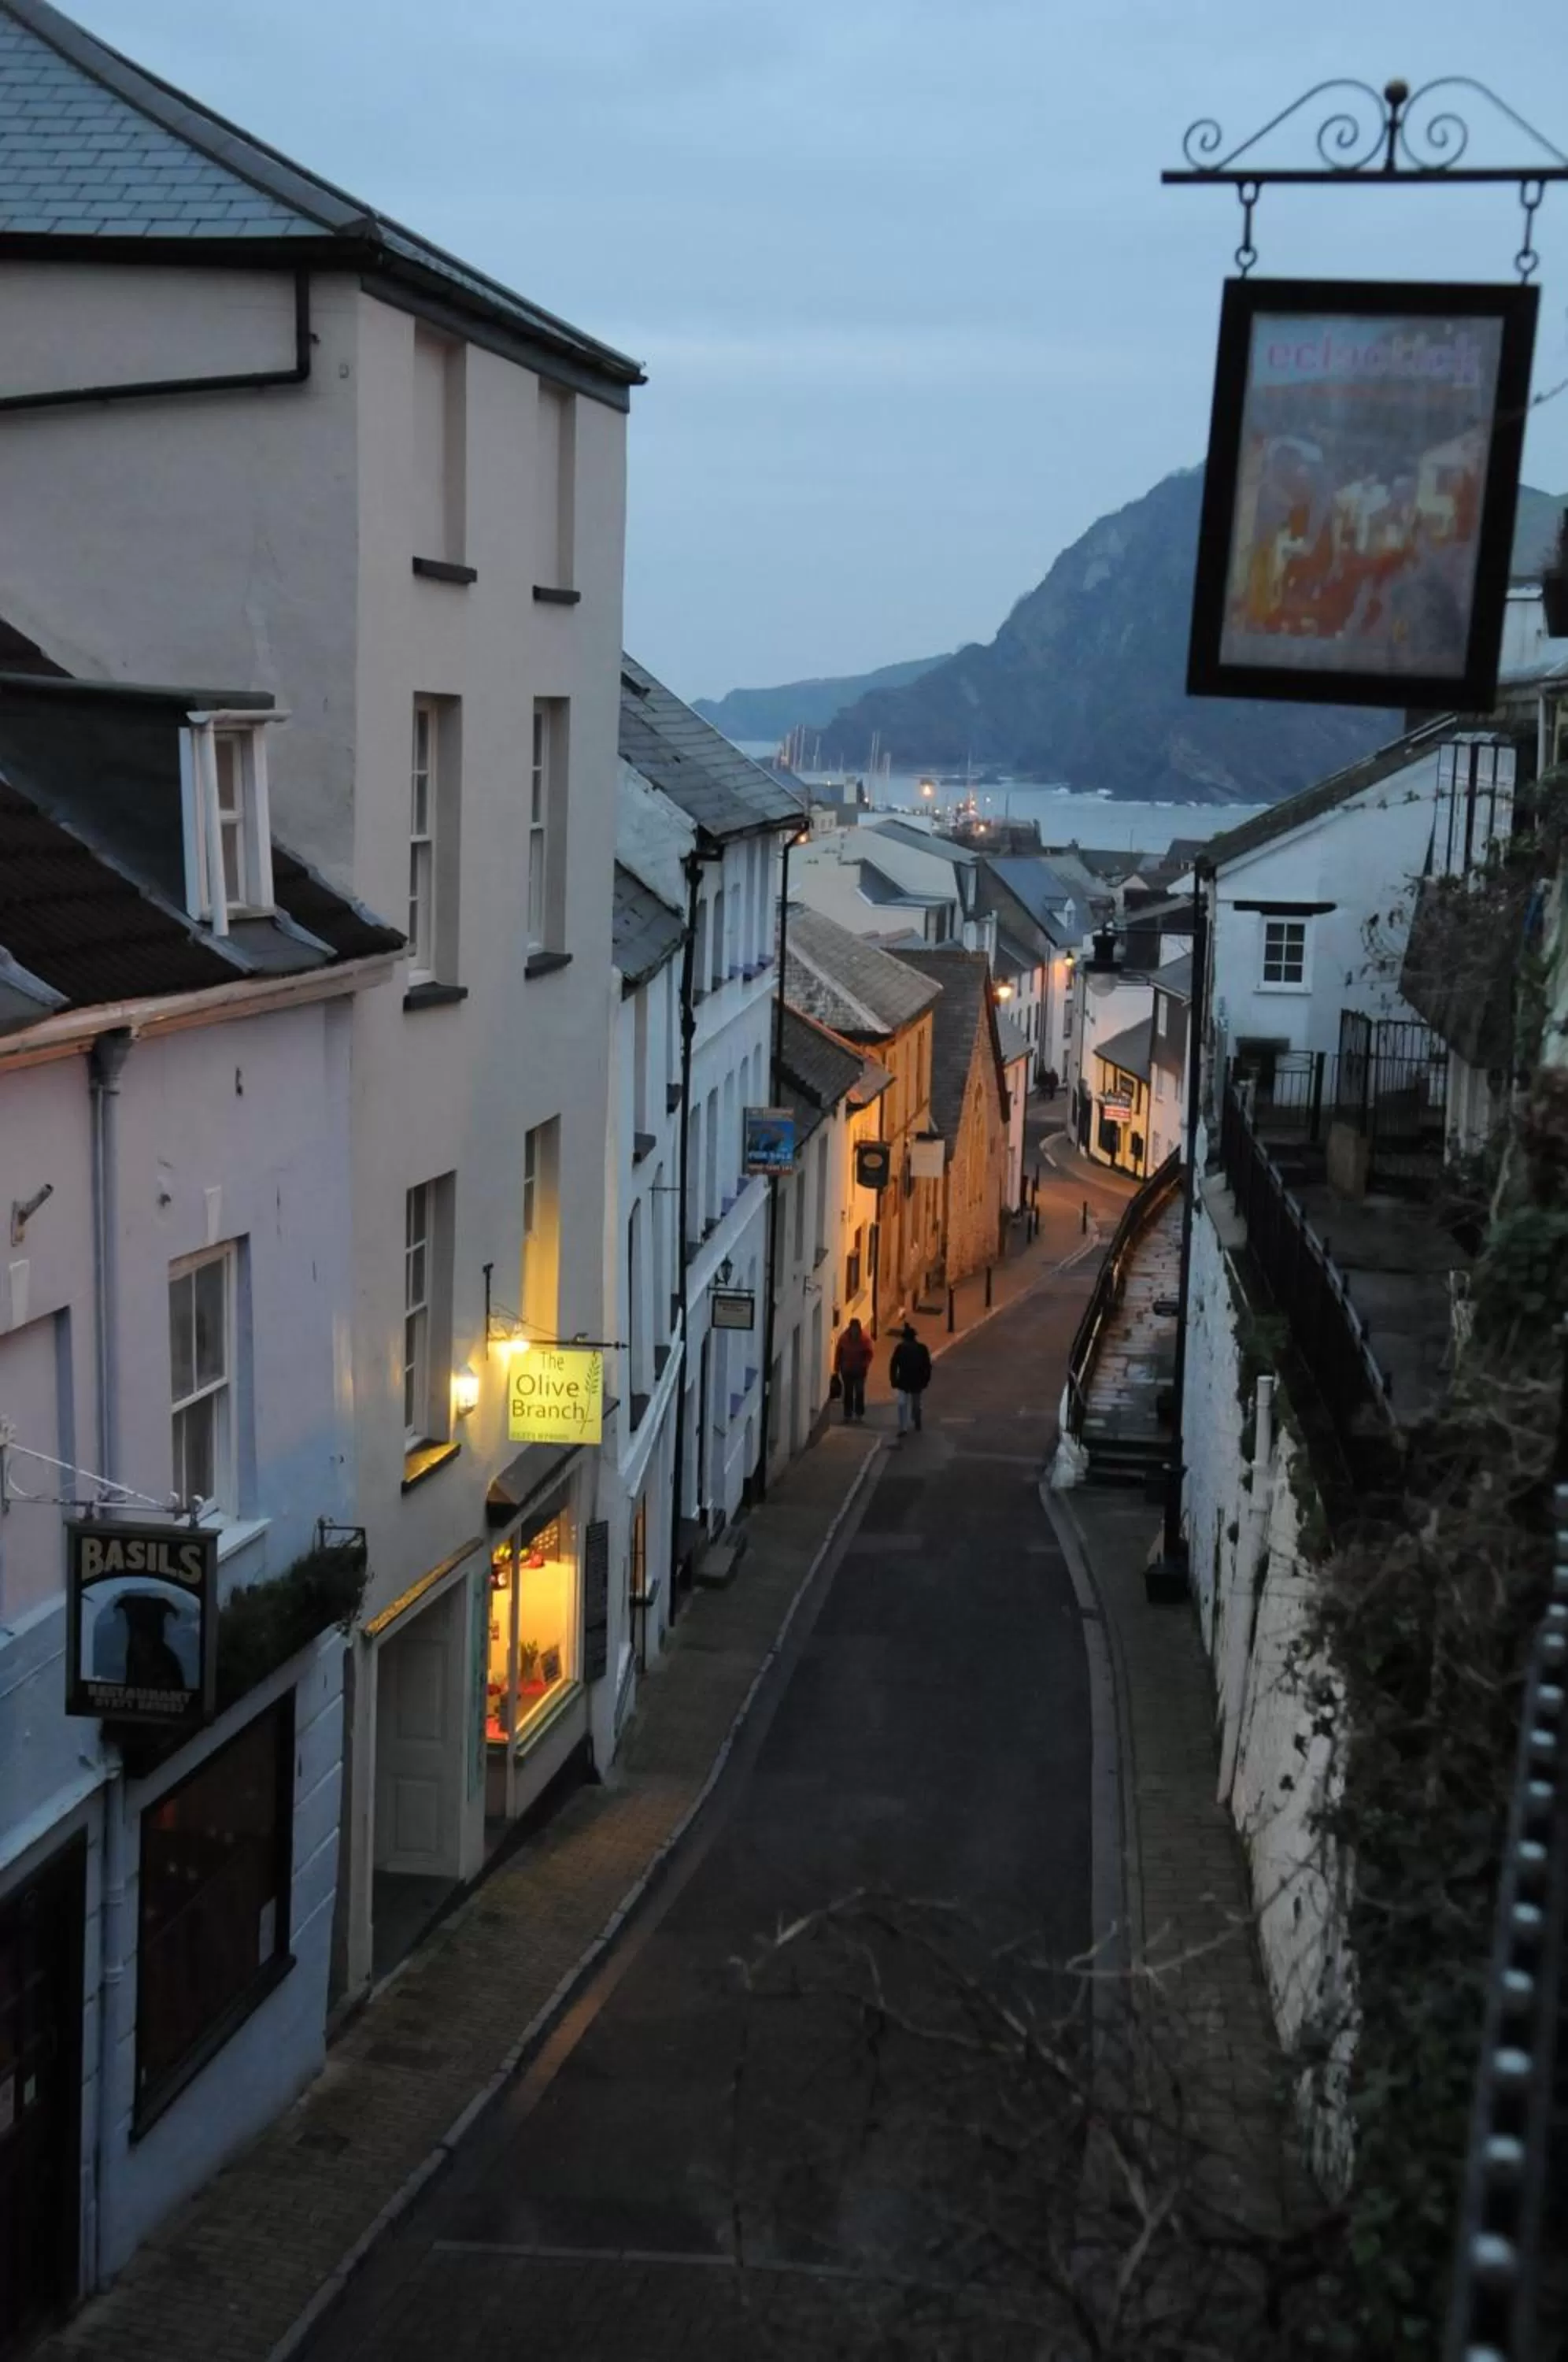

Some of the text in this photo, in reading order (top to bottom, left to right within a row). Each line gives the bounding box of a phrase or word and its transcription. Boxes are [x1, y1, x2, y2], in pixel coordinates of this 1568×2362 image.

[541, 1351, 564, 1371] The
[516, 1374, 579, 1398] Olive
[512, 1400, 585, 1420] Branch
[81, 1537, 202, 1584] BASILS
